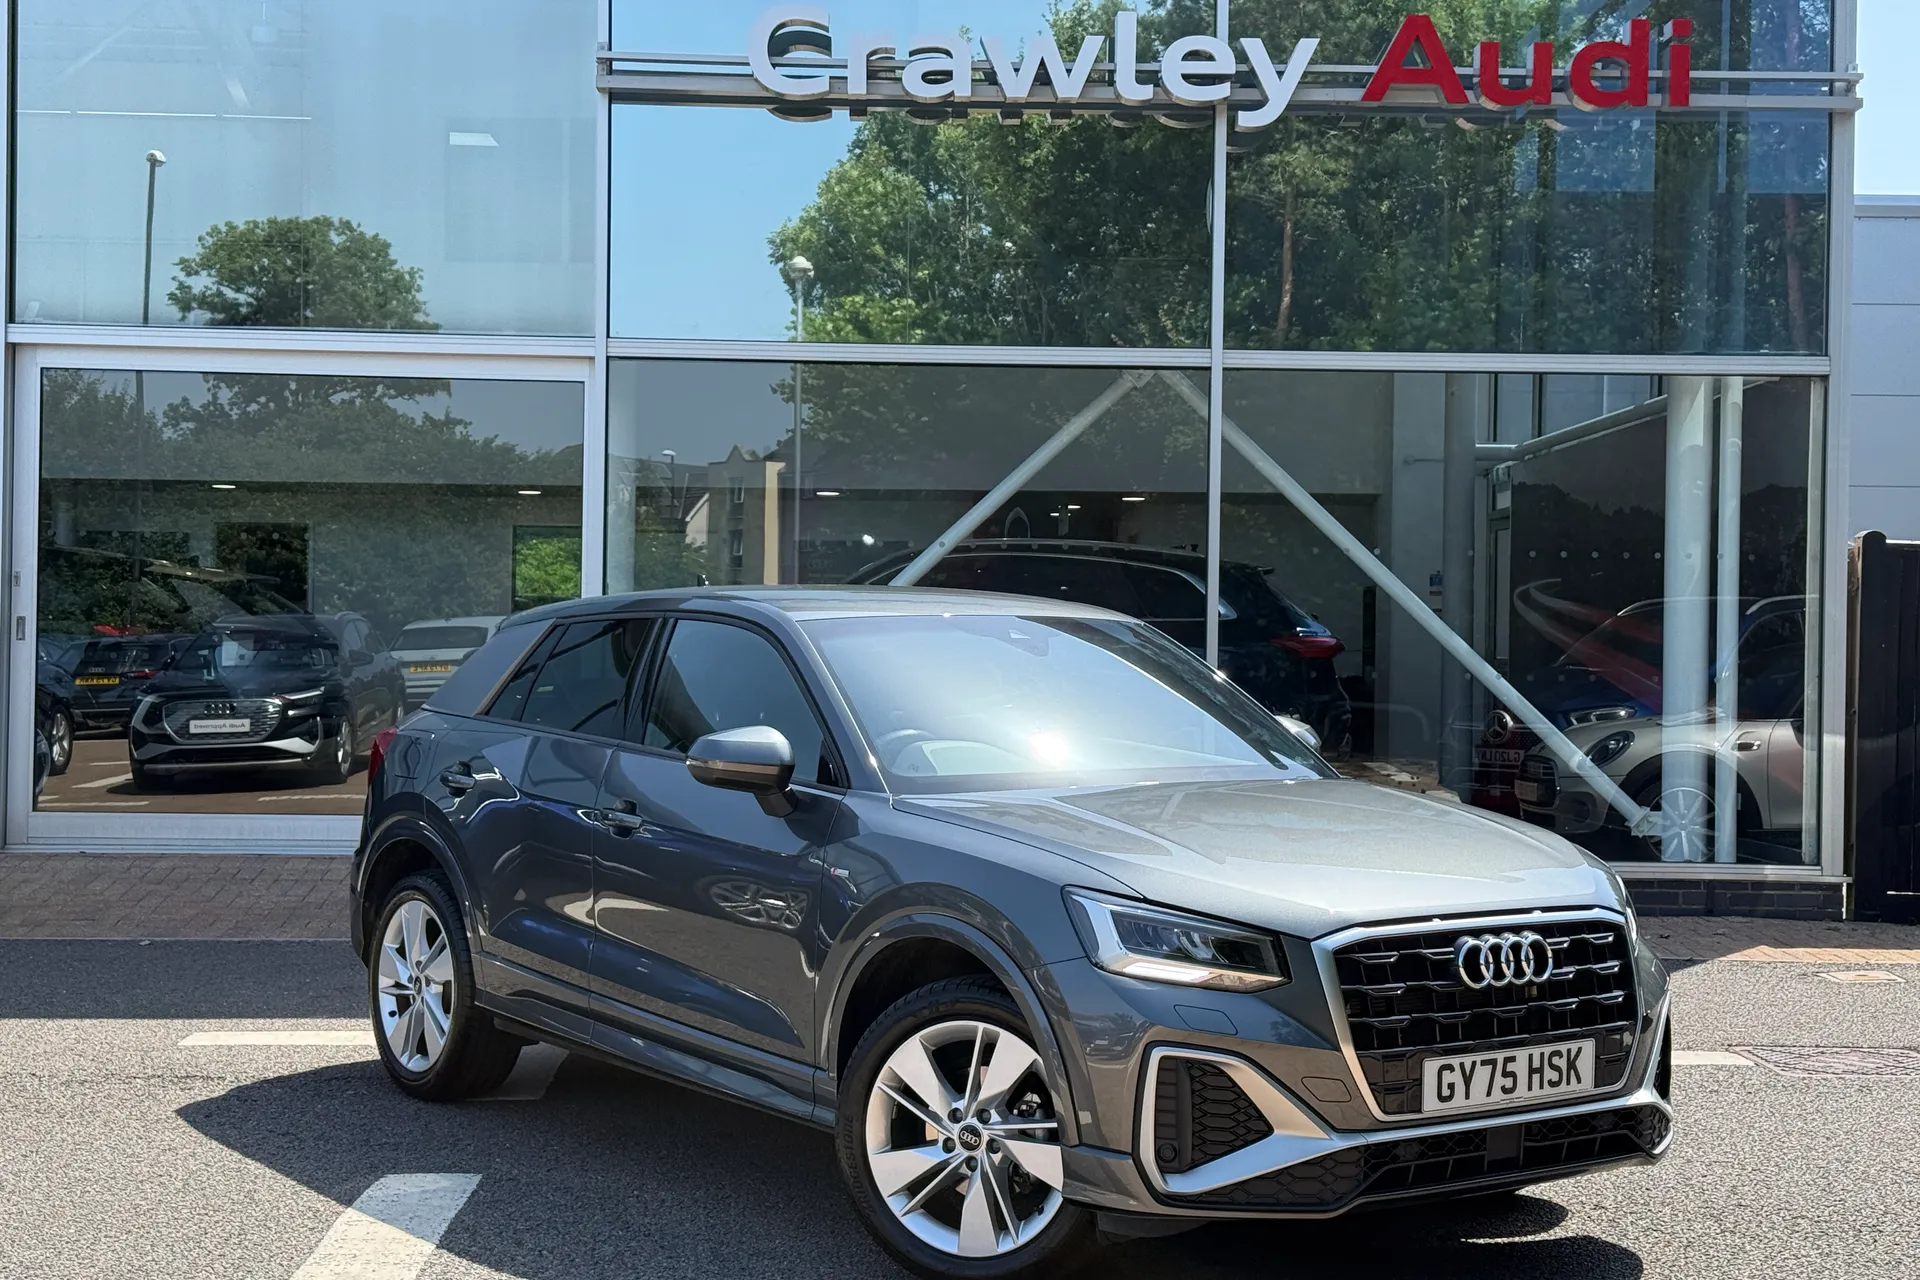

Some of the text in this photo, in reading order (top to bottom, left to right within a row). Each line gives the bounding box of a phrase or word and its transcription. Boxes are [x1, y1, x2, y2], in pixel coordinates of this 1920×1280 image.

[749, 11, 1692, 128] Crawley Audi
[1436, 1046, 1583, 1103] GY75 HSK
